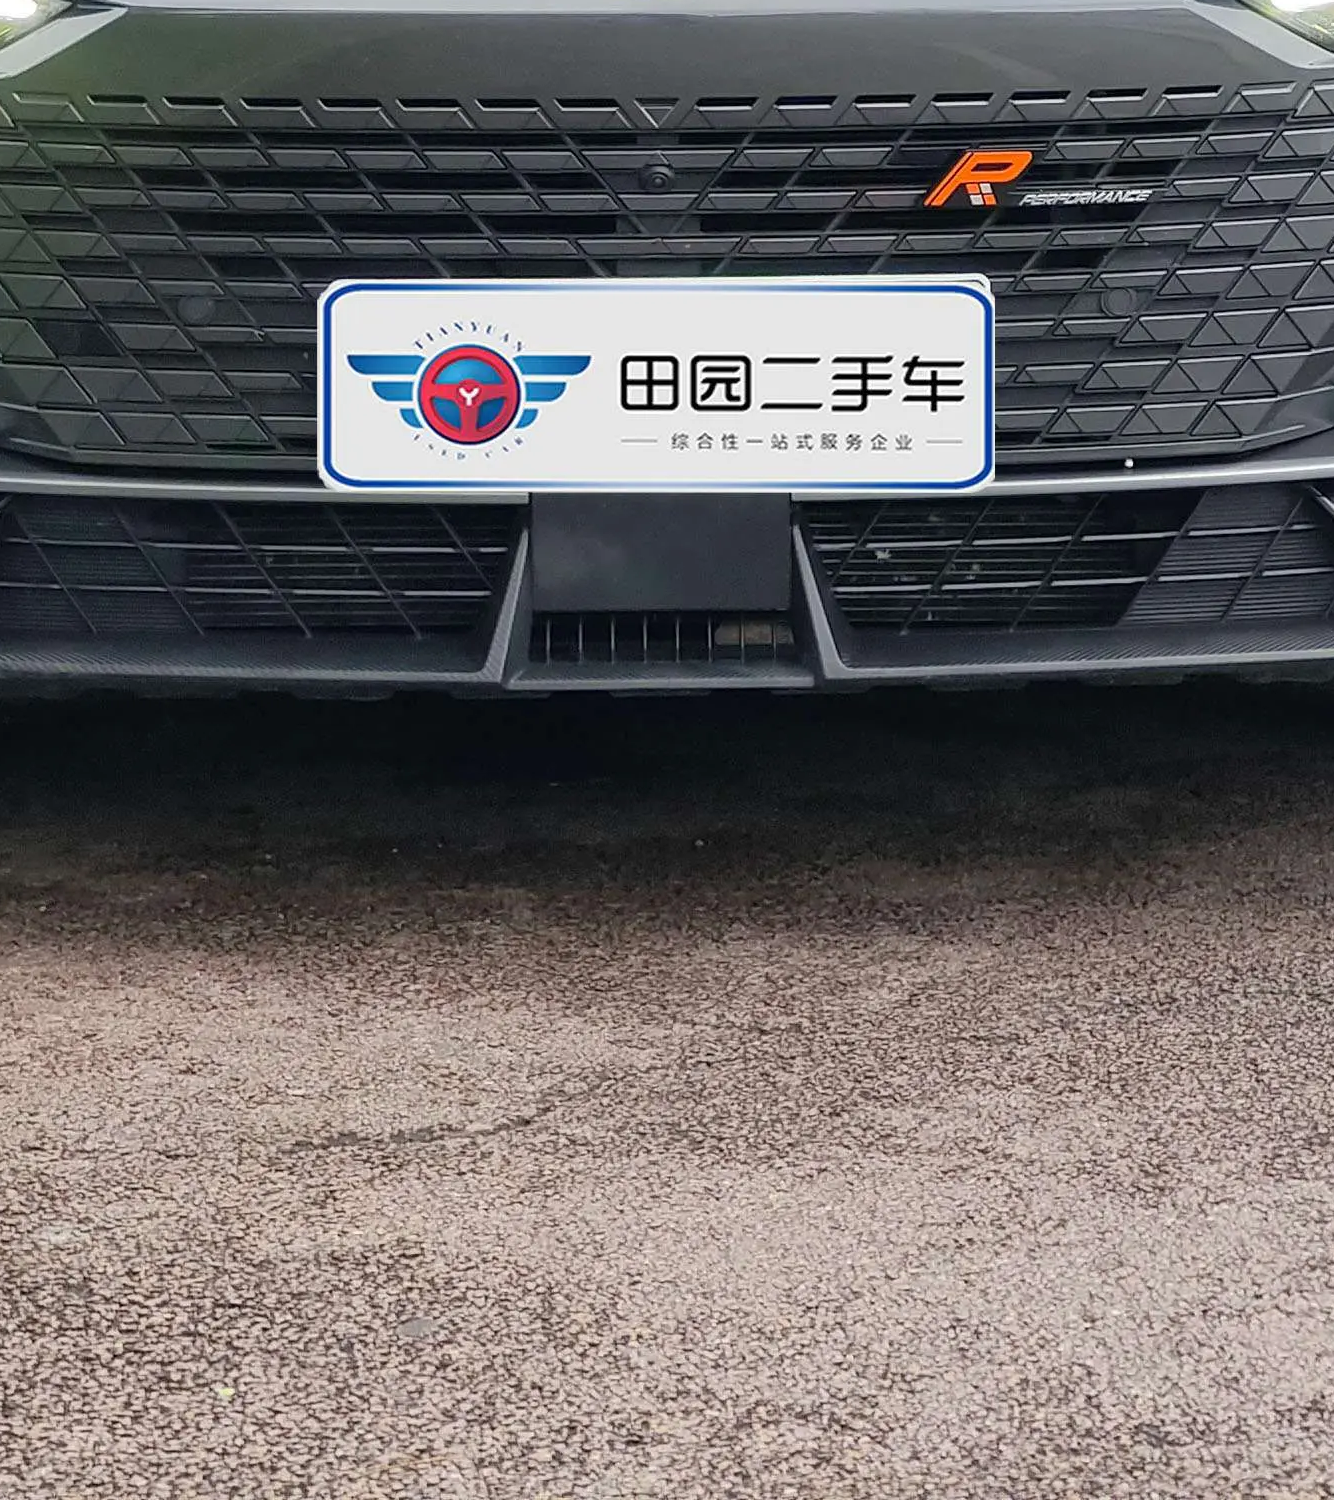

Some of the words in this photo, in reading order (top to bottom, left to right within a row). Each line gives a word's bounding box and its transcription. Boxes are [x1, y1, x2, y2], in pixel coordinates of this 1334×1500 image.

[1019, 189, 1153, 206] PERFORMANCE
[621, 355, 966, 412] 田园二手车
[671, 432, 913, 451] 综合性一站式服务企业
